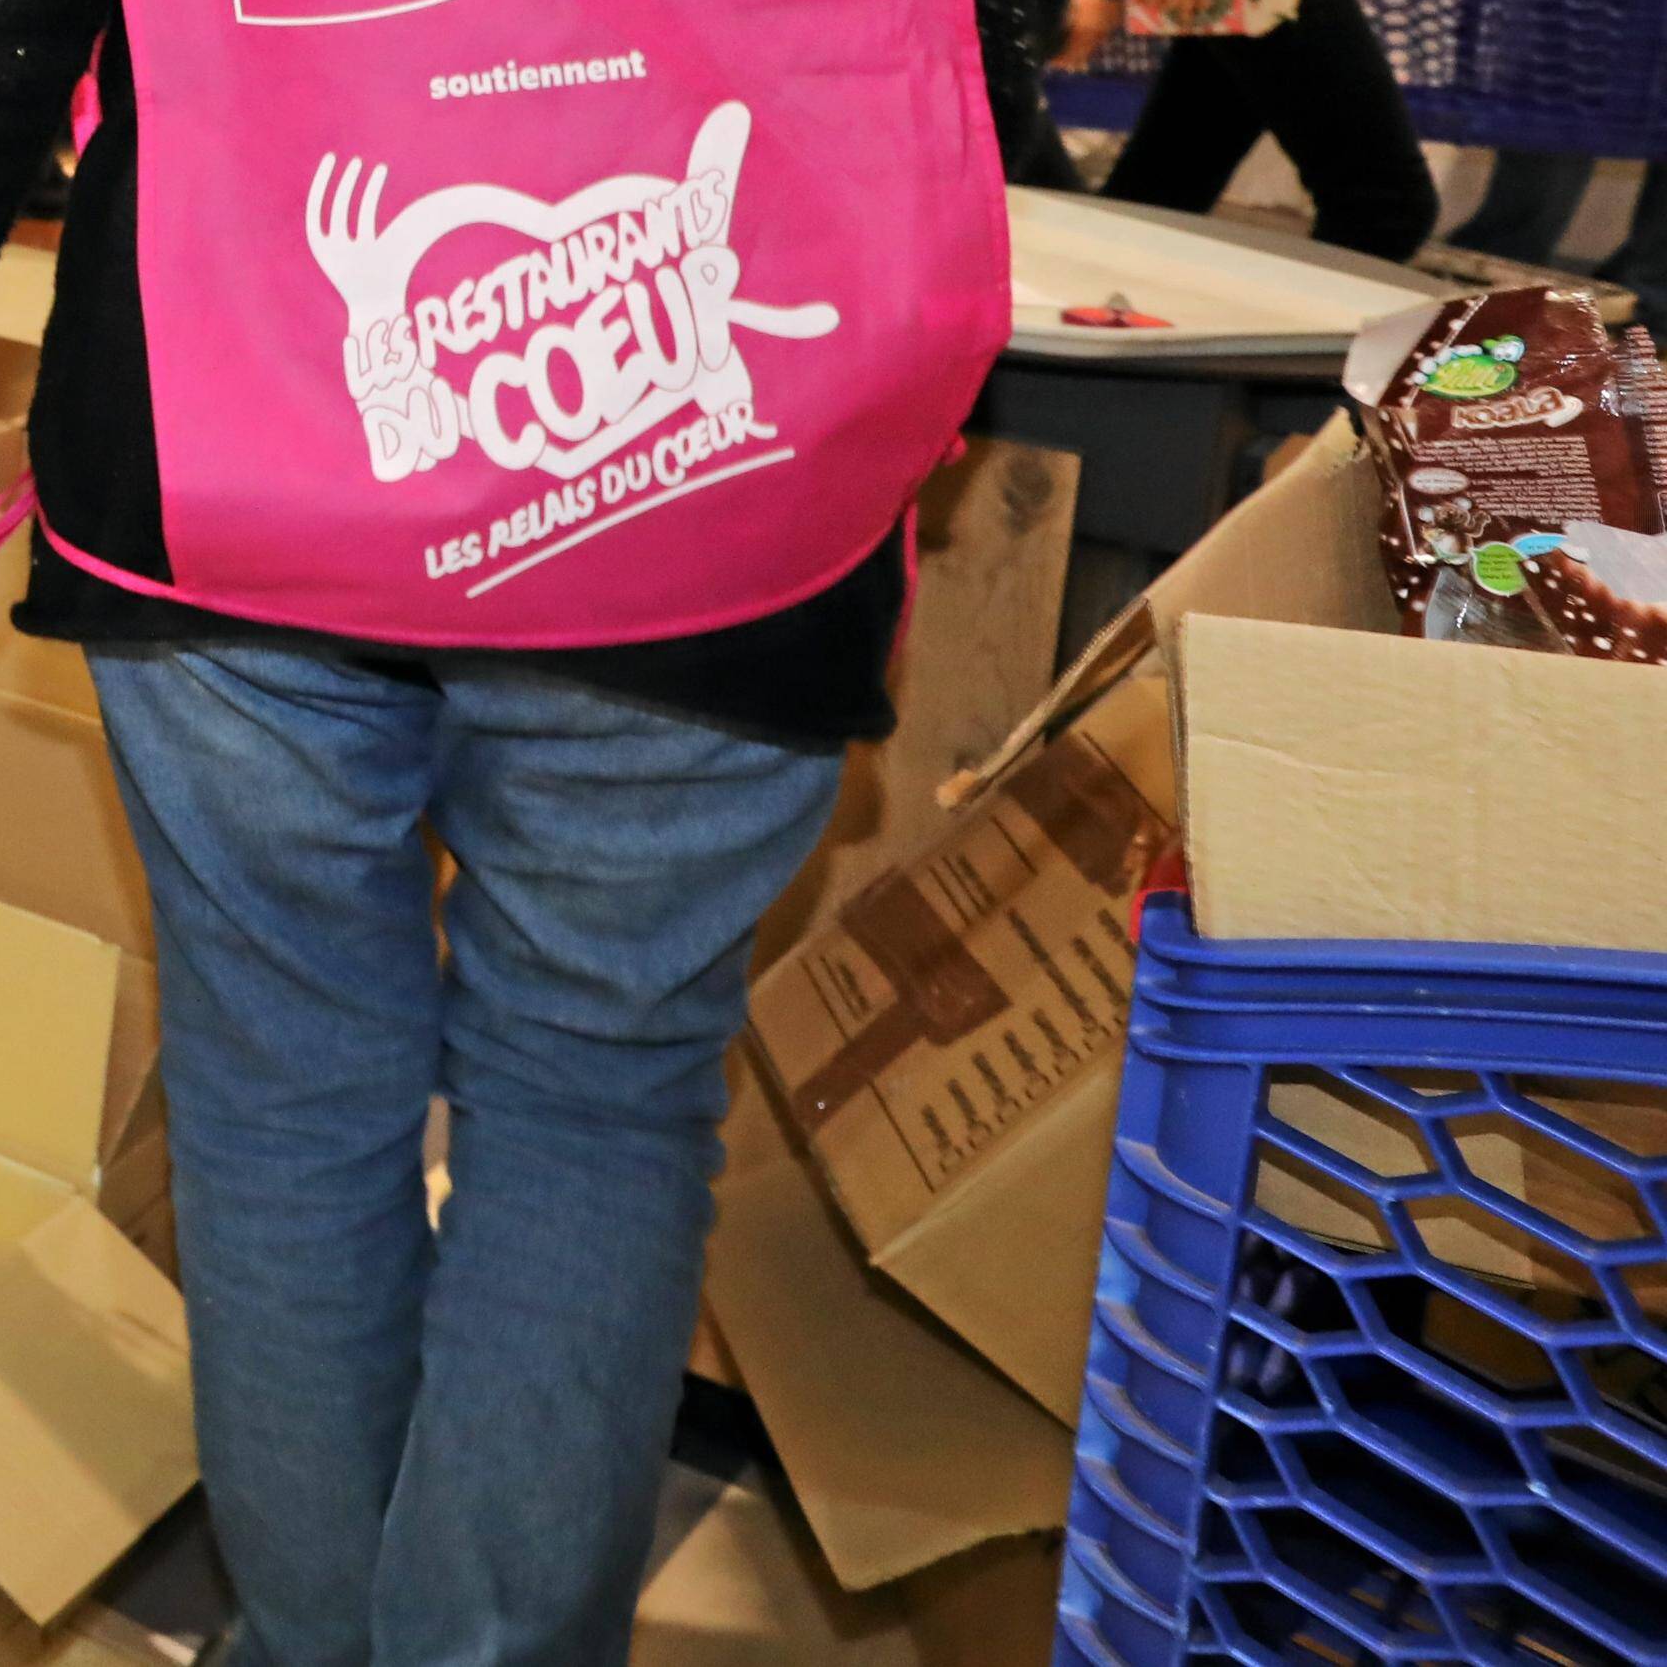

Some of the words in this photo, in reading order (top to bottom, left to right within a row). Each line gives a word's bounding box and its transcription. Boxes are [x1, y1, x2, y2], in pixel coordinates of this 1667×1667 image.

[429, 49, 647, 101] soutiennent
[343, 313, 419, 401] LES
[412, 168, 729, 369] RESTAURANTS
[364, 374, 462, 483] DU
[424, 529, 484, 580] LES
[486, 480, 598, 559] RELAIS
[600, 449, 654, 509] DU
